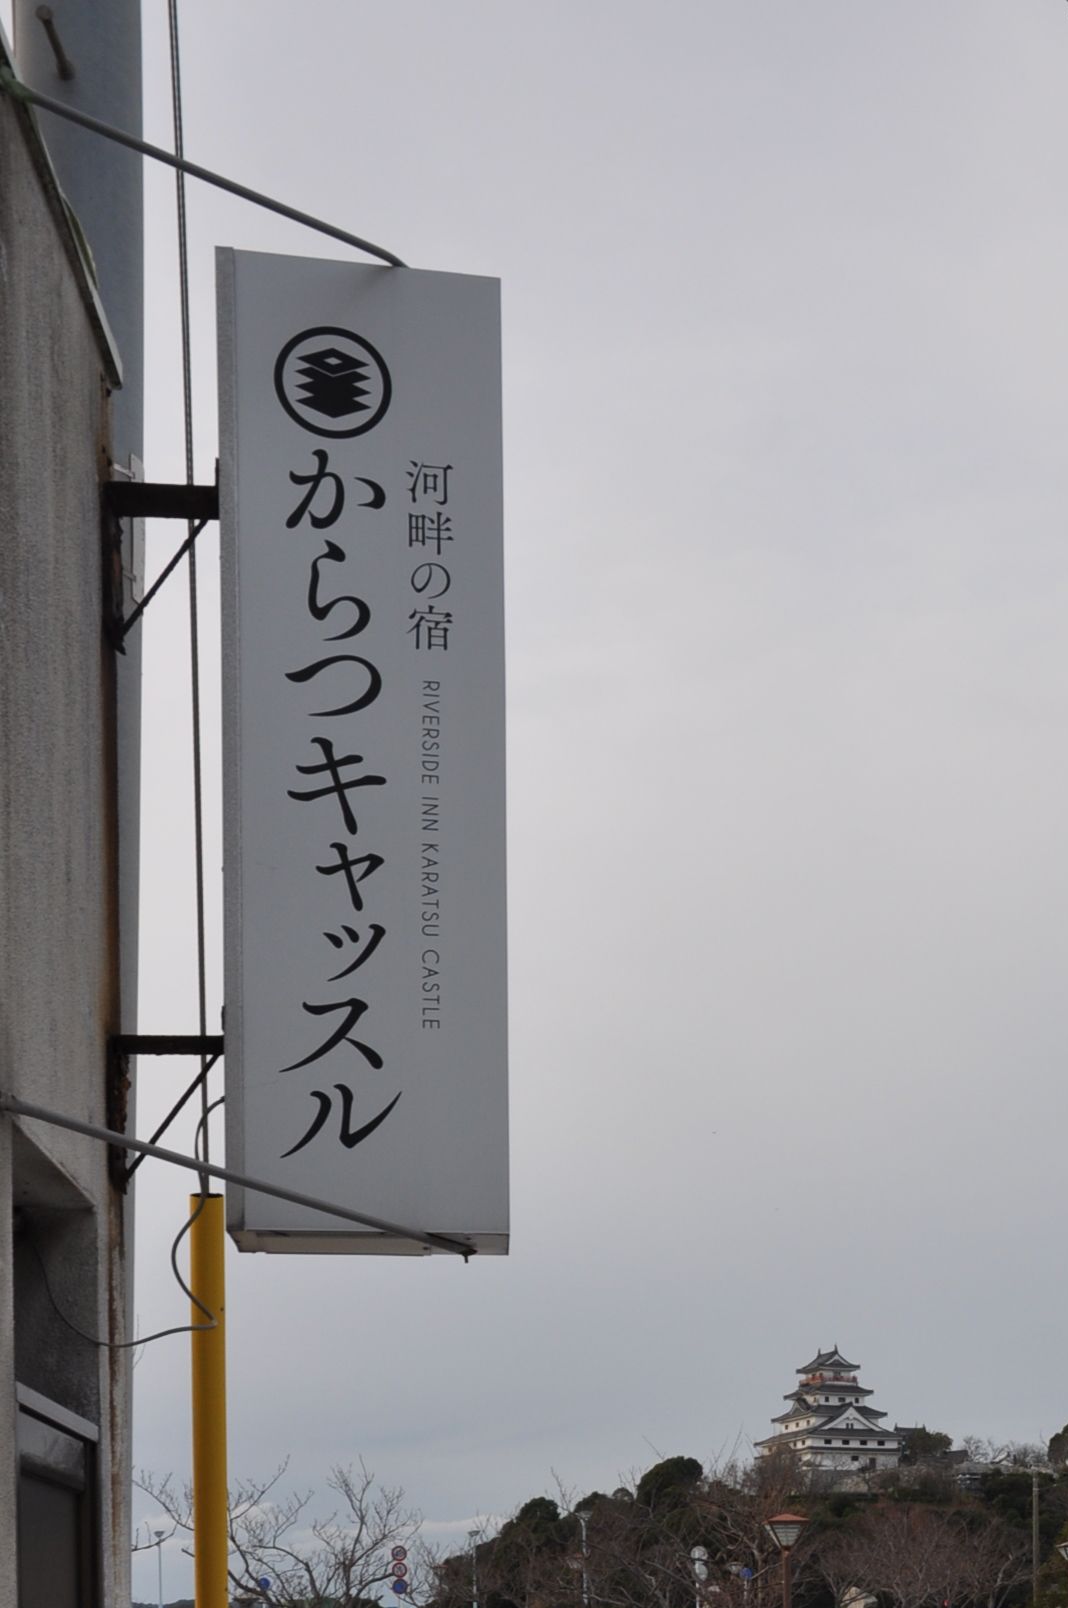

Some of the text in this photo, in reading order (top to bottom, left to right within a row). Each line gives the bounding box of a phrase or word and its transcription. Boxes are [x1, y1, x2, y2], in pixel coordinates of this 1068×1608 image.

[406, 459, 454, 652] 河畔の宿
[279, 448, 403, 1159] からつキャッスル
[420, 680, 441, 1030] RIVERSIDE INN KARATSU CASTLE
